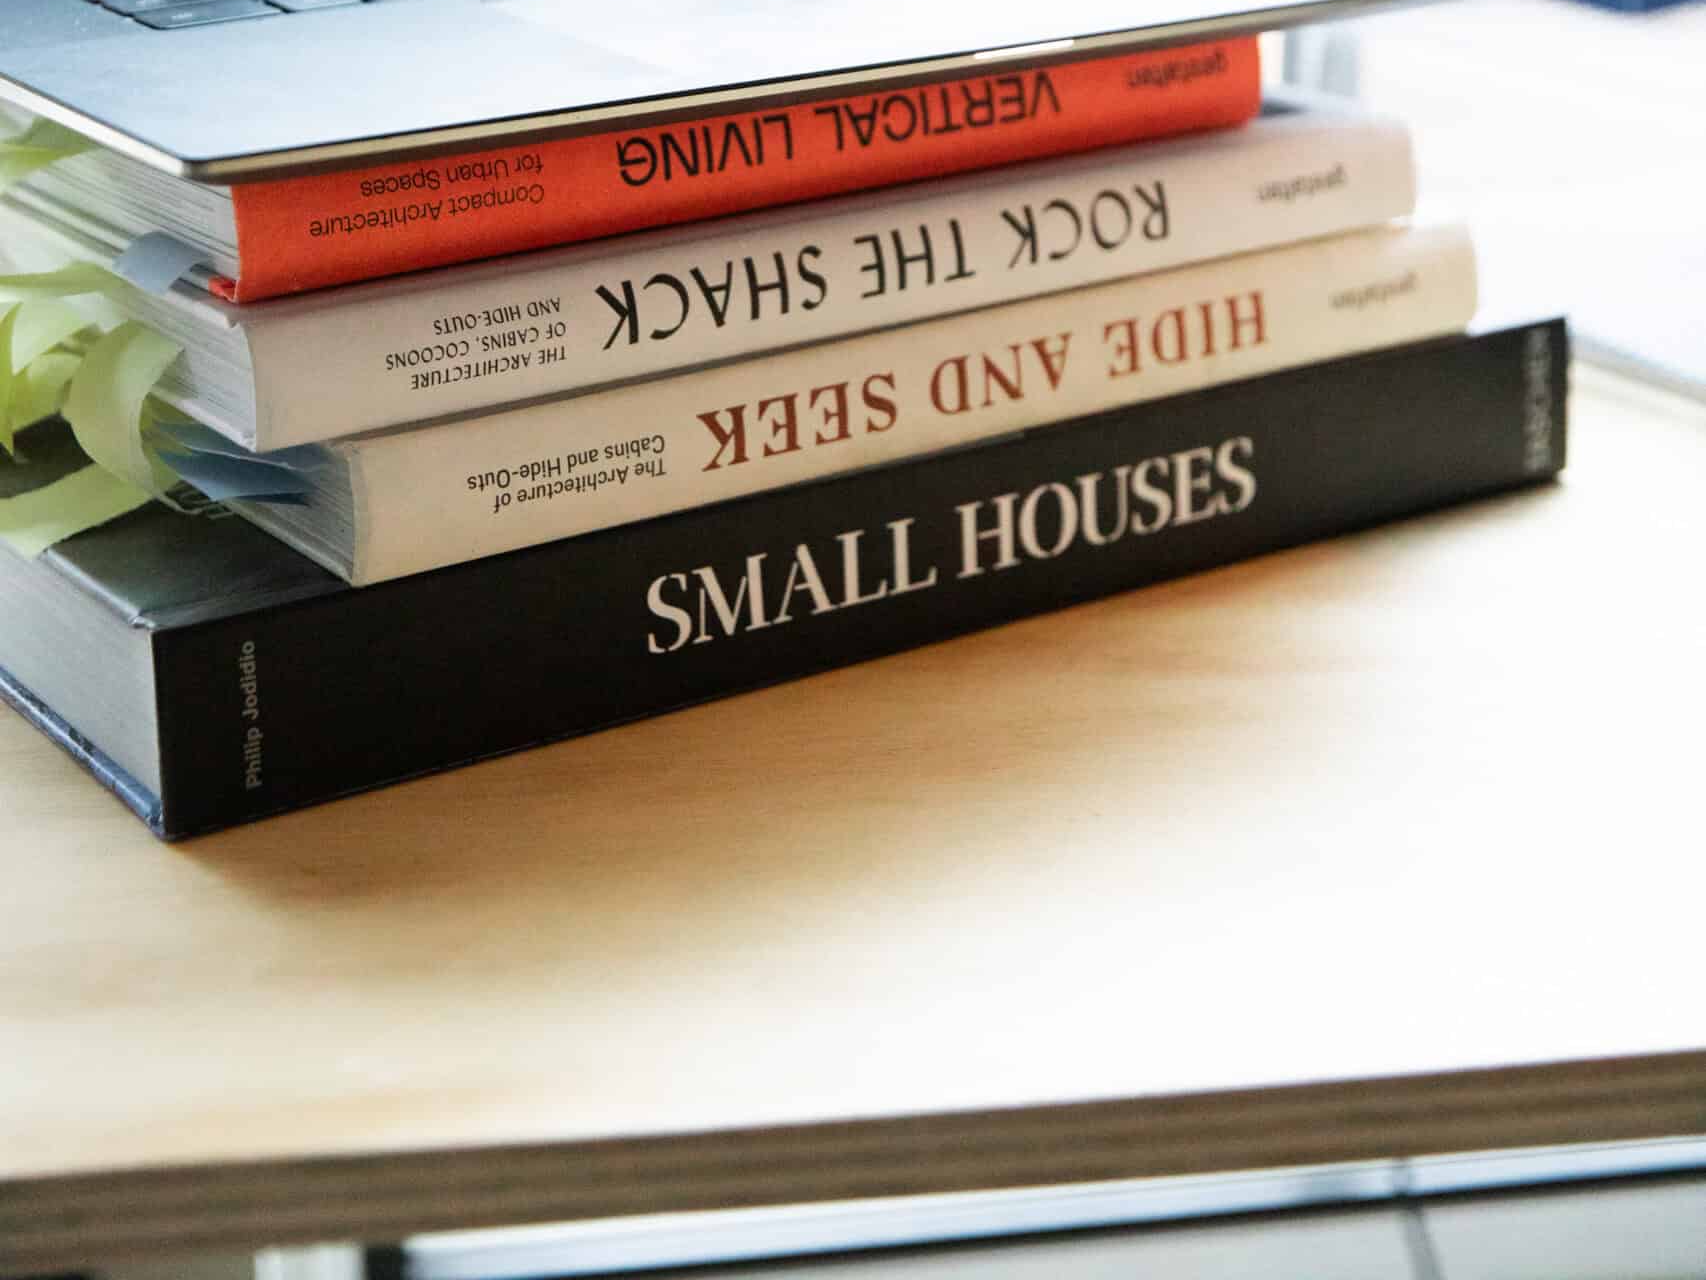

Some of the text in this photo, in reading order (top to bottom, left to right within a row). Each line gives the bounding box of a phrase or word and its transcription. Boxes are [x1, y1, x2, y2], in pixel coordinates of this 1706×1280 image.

[616, 72, 1061, 186] VERTICAL LIVING
[360, 153, 543, 197] for Urban Spaces
[309, 183, 544, 238] Compact Architecture
[594, 180, 1172, 351] ROCK THE SHACK
[433, 297, 561, 335] AND HIDE-OUTS
[385, 321, 567, 370] OF CABINS, COCOONS
[410, 346, 568, 390] THE ARCHITECTURE
[696, 289, 1271, 473] HIDE AND SEEK
[466, 434, 665, 491] Cabins and Hide-Outs
[493, 458, 667, 514] The Architecture of
[646, 435, 1257, 655] SMALL HOUSES
[239, 641, 263, 789] Philip Jodidio
